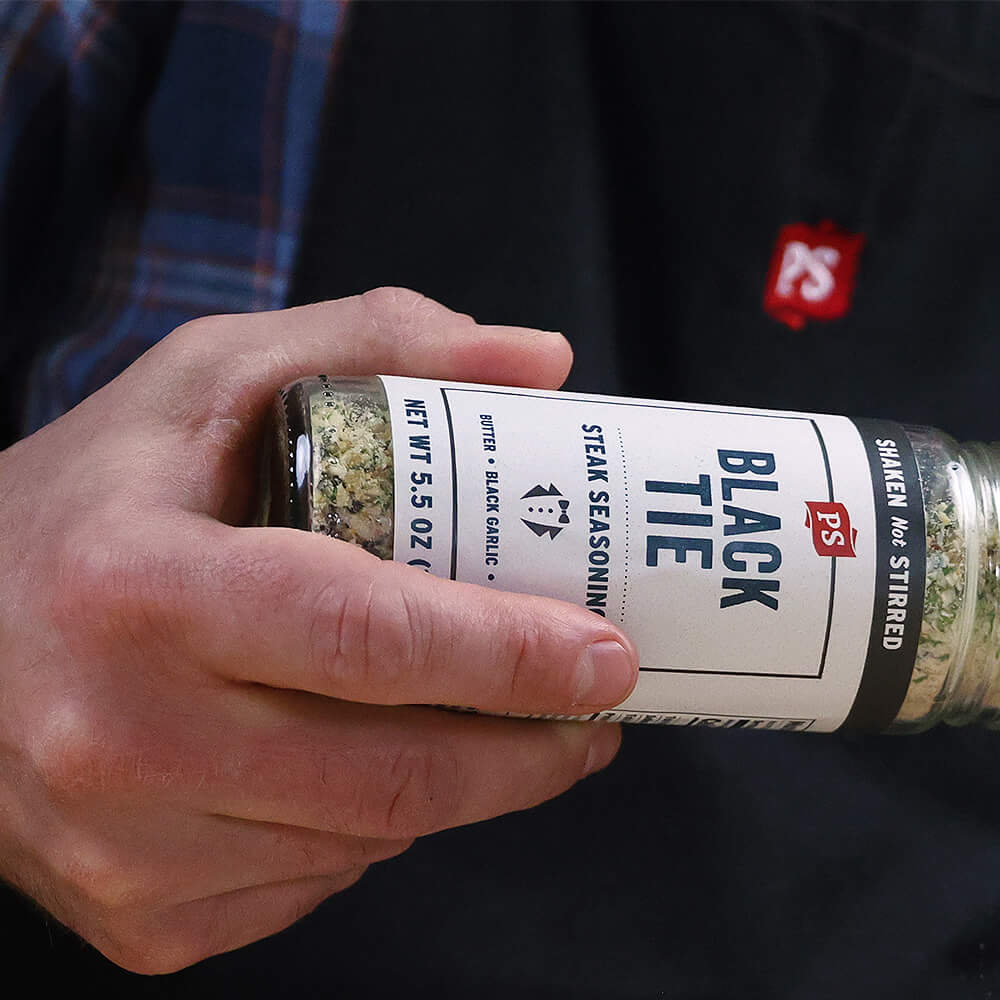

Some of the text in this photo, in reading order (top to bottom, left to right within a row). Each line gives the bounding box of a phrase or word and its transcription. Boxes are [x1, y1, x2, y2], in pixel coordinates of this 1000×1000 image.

[776, 240, 841, 302] PS
[403, 398, 429, 428] NET
[408, 435, 432, 464] WT
[581, 423, 609, 483] STEAK
[410, 471, 433, 509] 5.5
[479, 413, 500, 567] BUTTER BLACK GARLIC
[410, 517, 433, 550] OZ
[645, 474, 713, 569] TIE
[717, 449, 782, 611] BLACK
[816, 510, 845, 547] PS
[875, 437, 910, 651] SHAKEN Not STIRRED
